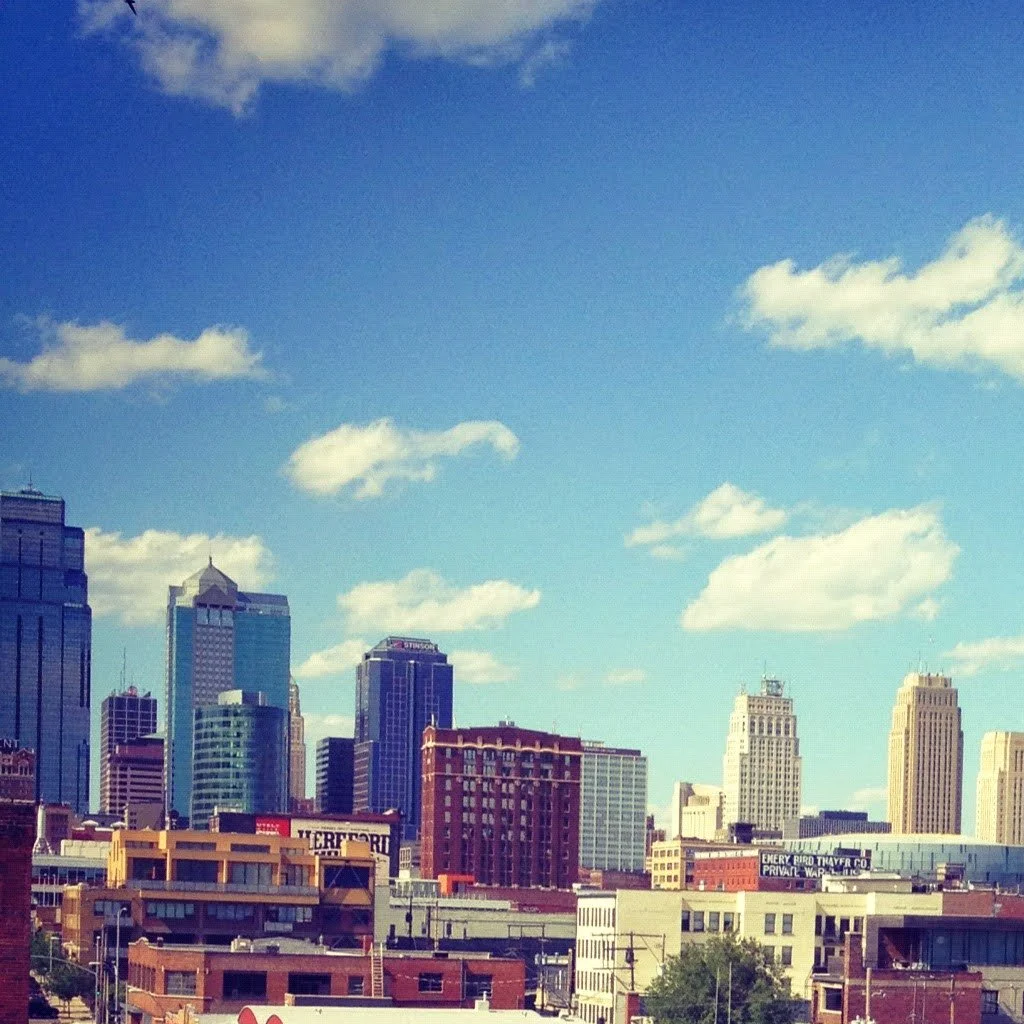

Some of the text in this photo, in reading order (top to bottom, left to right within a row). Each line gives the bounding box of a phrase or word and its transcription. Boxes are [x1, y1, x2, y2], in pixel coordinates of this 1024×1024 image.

[762, 854, 790, 864] EMERY
[793, 855, 814, 866] BIRD
[817, 856, 851, 867] THAYER
